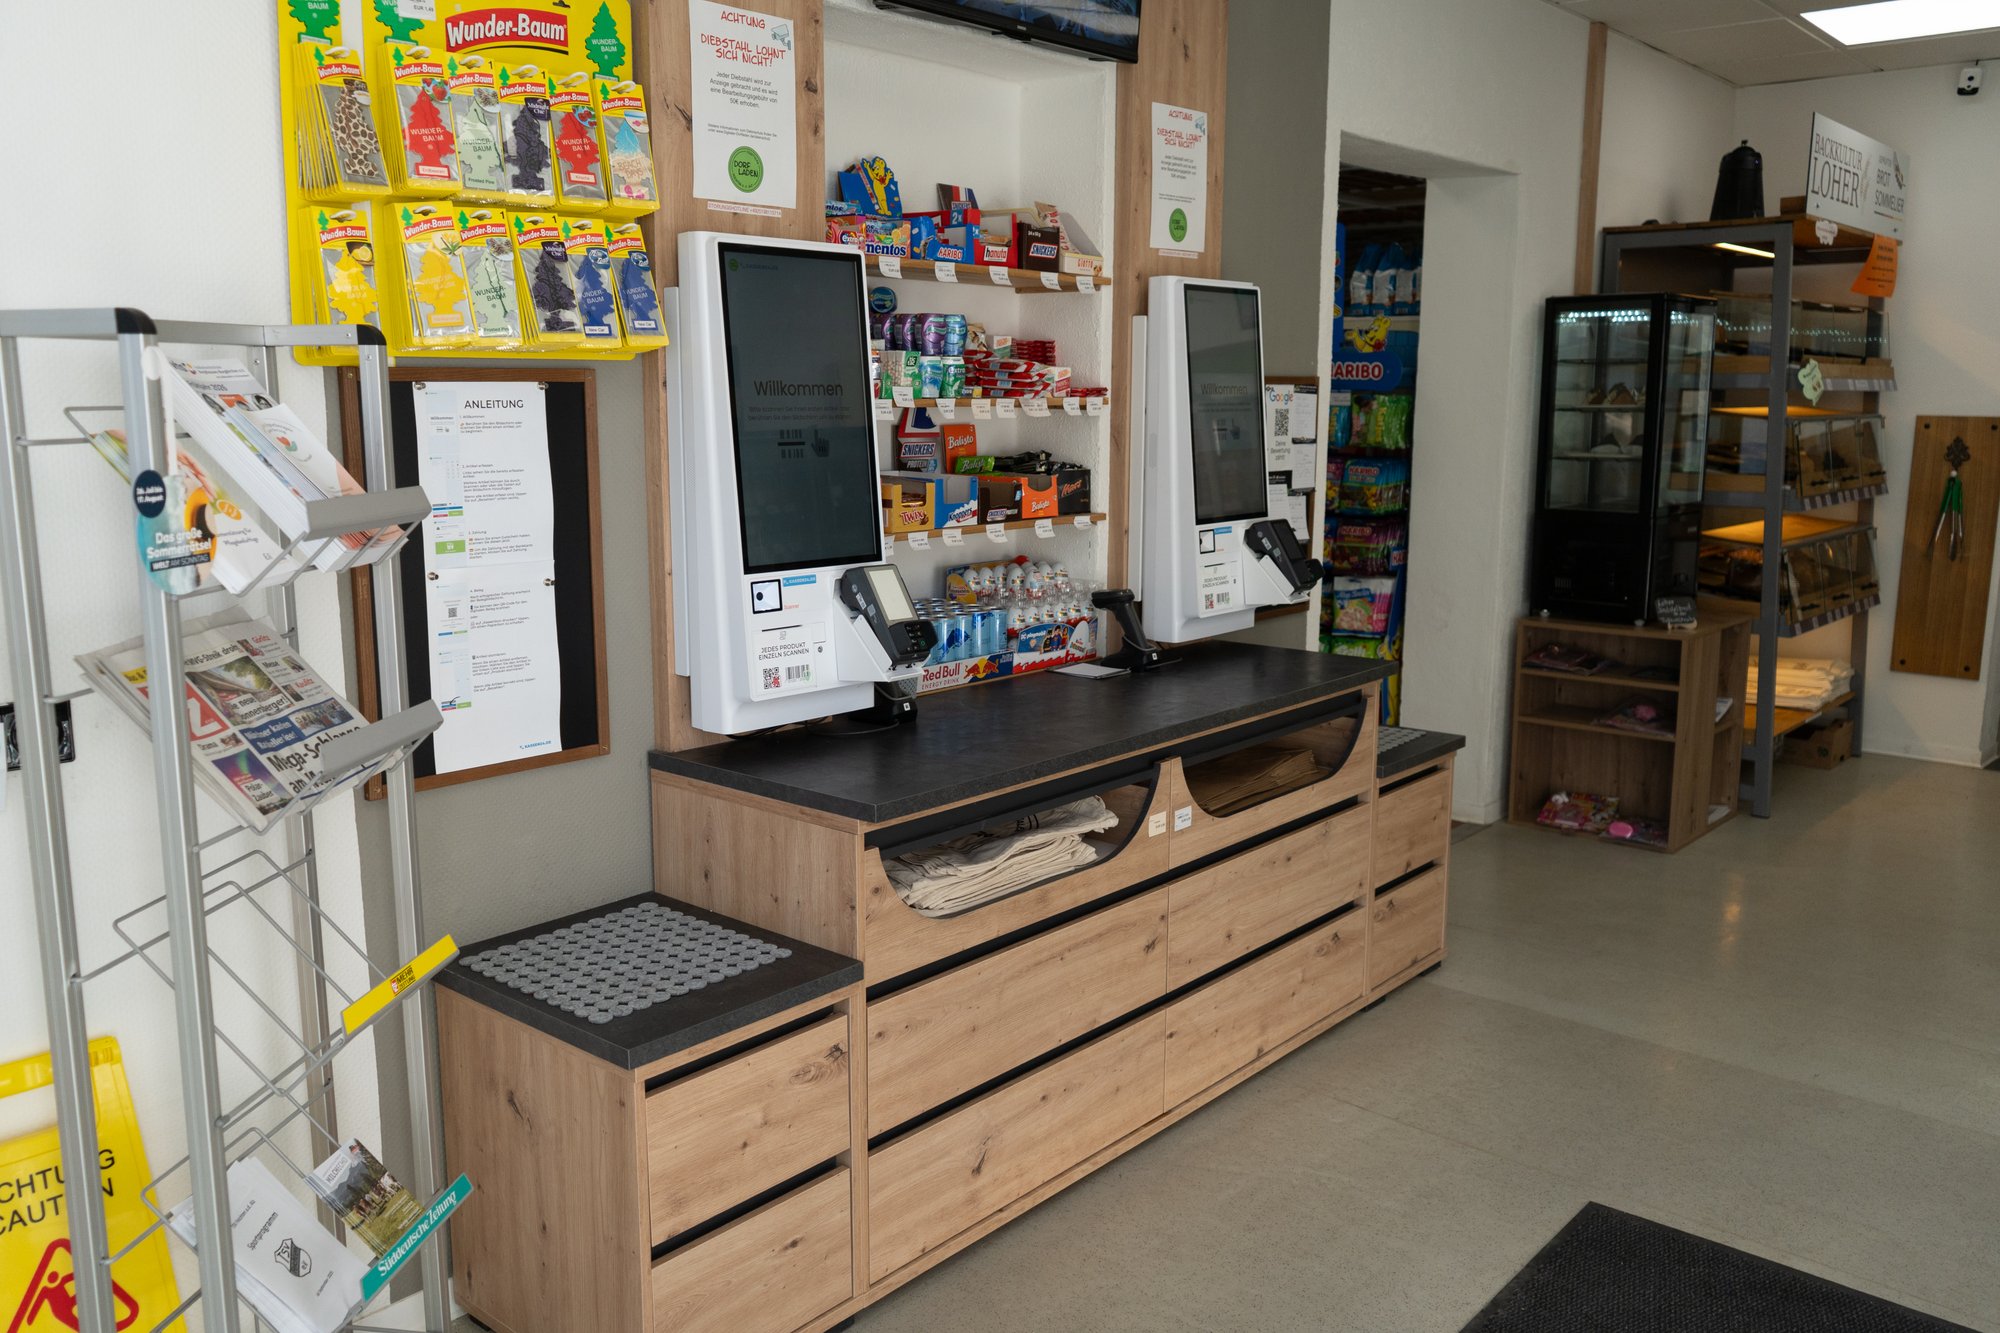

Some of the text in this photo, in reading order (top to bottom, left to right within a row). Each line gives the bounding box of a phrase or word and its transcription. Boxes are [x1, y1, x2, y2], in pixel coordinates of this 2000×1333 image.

[307, 2, 329, 10] BAUM
[720, 10, 766, 29] ACHTUNG
[446, 13, 566, 47] Wunder-Baum
[700, 33, 787, 60] DIEBSTAHL LOHNT
[715, 47, 773, 68] SICH NICHT!
[317, 64, 361, 79] Wunder-Baum
[395, 64, 443, 78] Wunder-Baum
[449, 73, 494, 88] Wunder-Baum
[500, 84, 545, 97] Wunder-Baum
[550, 93, 589, 105] Wunder-Baum
[602, 99, 641, 111] Wunder-Baum
[410, 127, 444, 136] WUNDER-
[472, 144, 492, 153] BAUM
[1814, 132, 1863, 172] BACKKULTUR
[734, 160, 751, 169] DORF
[737, 168, 759, 178] LADEN
[1811, 156, 1860, 209] LOHER
[320, 228, 366, 243] Wunder-Baum
[404, 219, 453, 238] Wunder-Baum
[461, 224, 506, 241] Wunder-Baum
[518, 229, 559, 243] Wunder-Baum
[565, 234, 604, 248] Wunder-Baum
[608, 240, 642, 252] Wunder-Baum
[865, 243, 907, 257] mentos
[937, 246, 962, 260] HARIBO
[1031, 244, 1057, 257] SNICKERS
[475, 286, 507, 297] WUNDER-
[486, 292, 507, 302] BAUM
[586, 296, 605, 305] BAUM
[753, 379, 844, 397] Willkommen
[1200, 383, 1248, 396] Willkommen
[464, 399, 524, 409] ANLEITUNG
[1269, 390, 1294, 405] Google
[947, 435, 974, 449] Balisto
[902, 443, 935, 456] SNICKERS
[1031, 500, 1051, 512] Balisto
[901, 509, 924, 525] Twix
[948, 507, 973, 521] Knoppers
[155, 532, 175, 544] Das
[176, 527, 202, 543] große
[146, 538, 212, 559] Sommerrätsel
[151, 561, 170, 571] WELT
[758, 648, 810, 661] EINZELN SCANNEN
[761, 642, 806, 654] JEDES PRODUKT
[922, 662, 961, 682] Red Bull
[921, 678, 960, 690] ENERGY DRINK
[396, 966, 415, 985] MEHR
[247, 1211, 279, 1251] Sportprogramm
[377, 1220, 430, 1277] Süddeutsche
[426, 1190, 457, 1227] Zeitung
[277, 1241, 290, 1264] TSV
